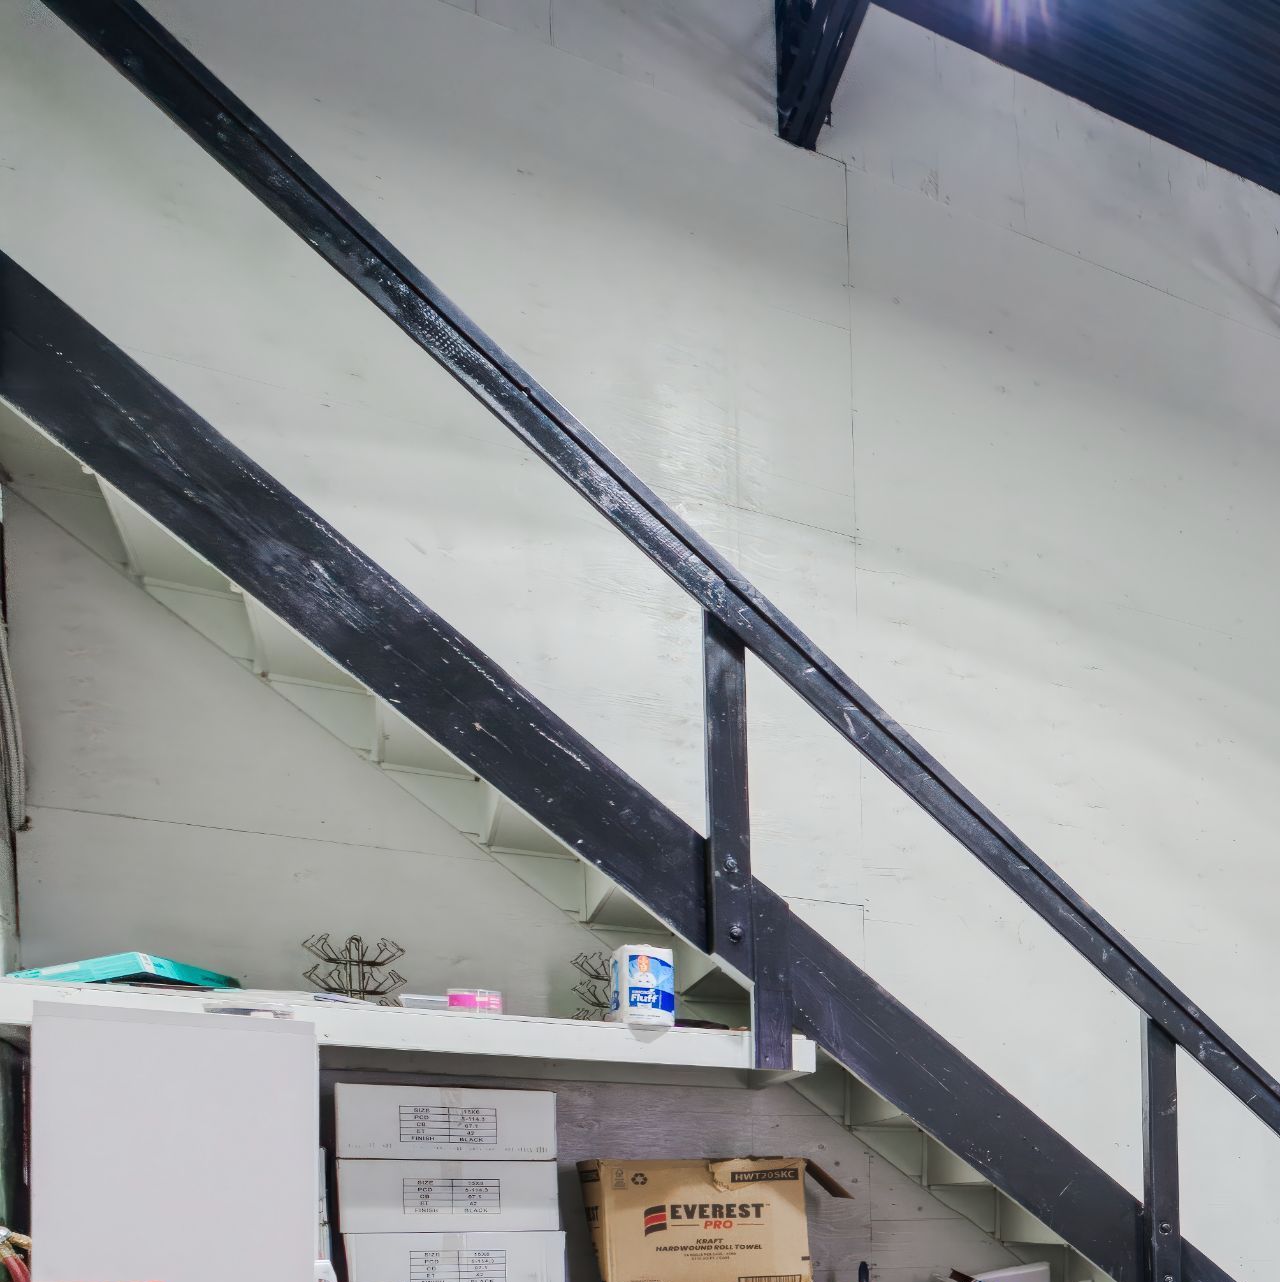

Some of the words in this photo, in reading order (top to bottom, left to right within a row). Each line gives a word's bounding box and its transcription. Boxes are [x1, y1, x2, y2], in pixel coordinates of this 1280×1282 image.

[631, 994, 659, 1003] Fluff
[670, 1203, 764, 1219] EVEREST
[703, 1220, 733, 1229] PRO
